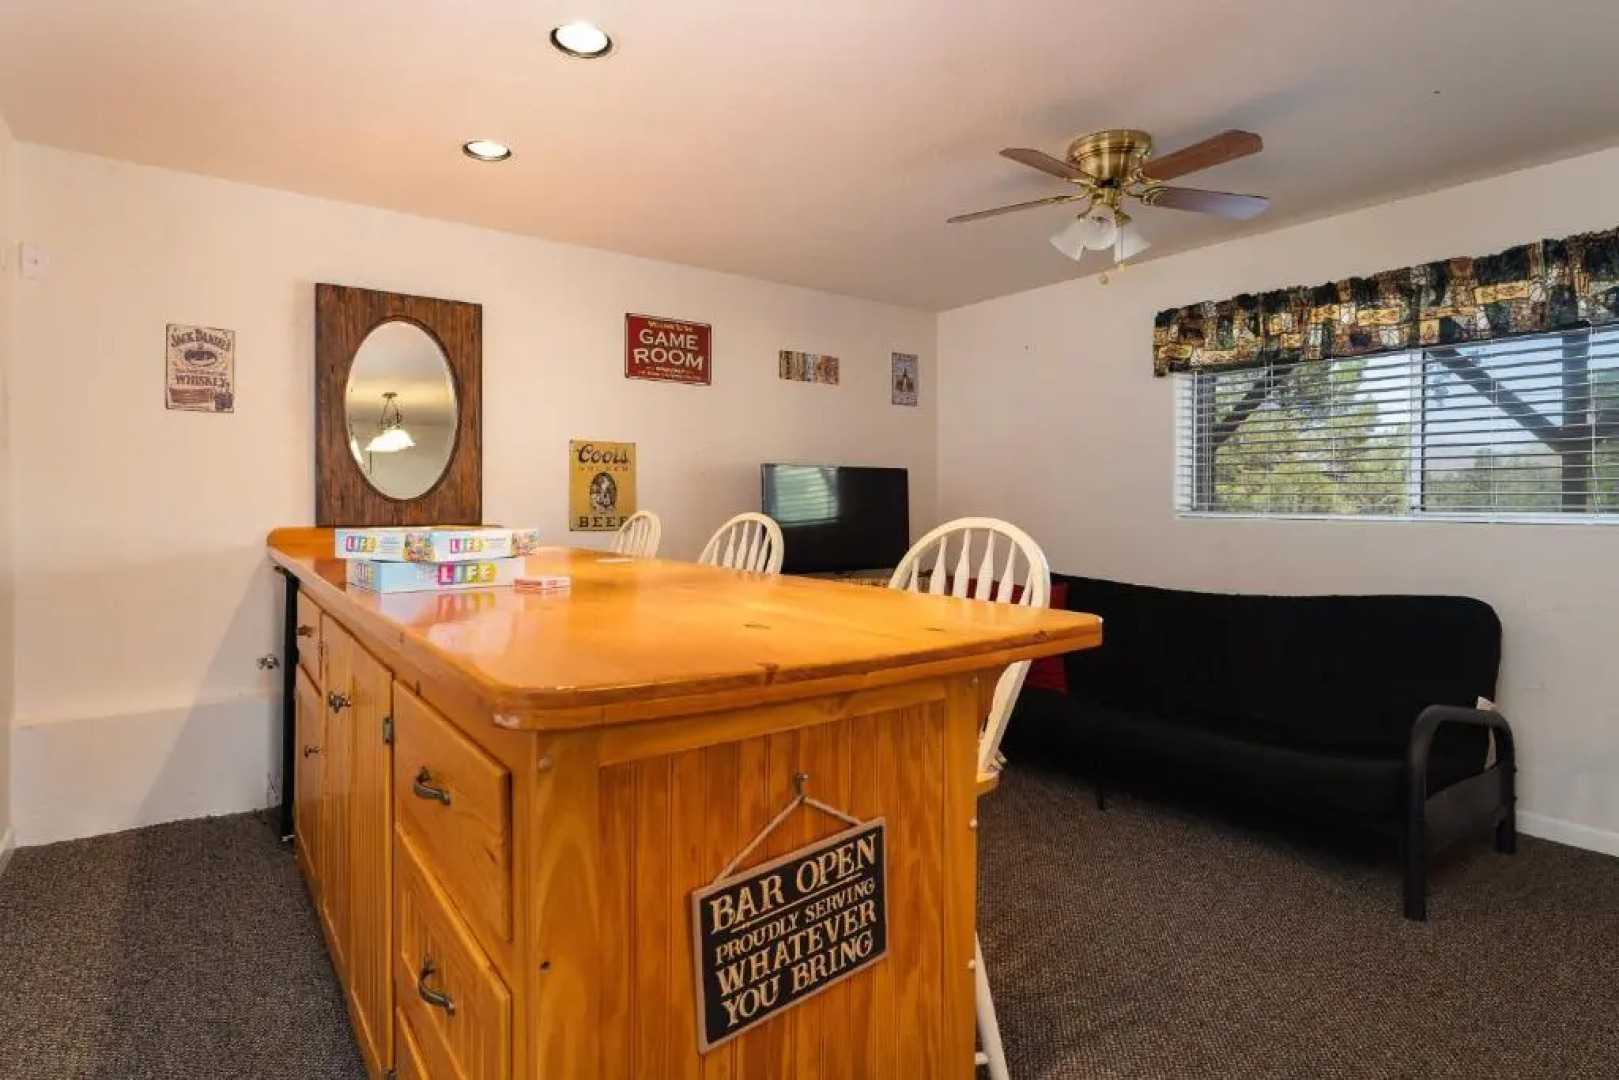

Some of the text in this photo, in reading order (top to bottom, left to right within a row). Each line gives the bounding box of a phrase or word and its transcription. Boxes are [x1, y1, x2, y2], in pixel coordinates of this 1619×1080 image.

[633, 347, 704, 371] ROOM
[639, 328, 699, 351] GAME
[438, 562, 495, 585] LIFE
[710, 833, 876, 935] BAR OPEN
[715, 877, 875, 967] PROUDLY SERVING
[715, 899, 877, 997] WHATEVER
[721, 930, 874, 1027] YOU BRING
